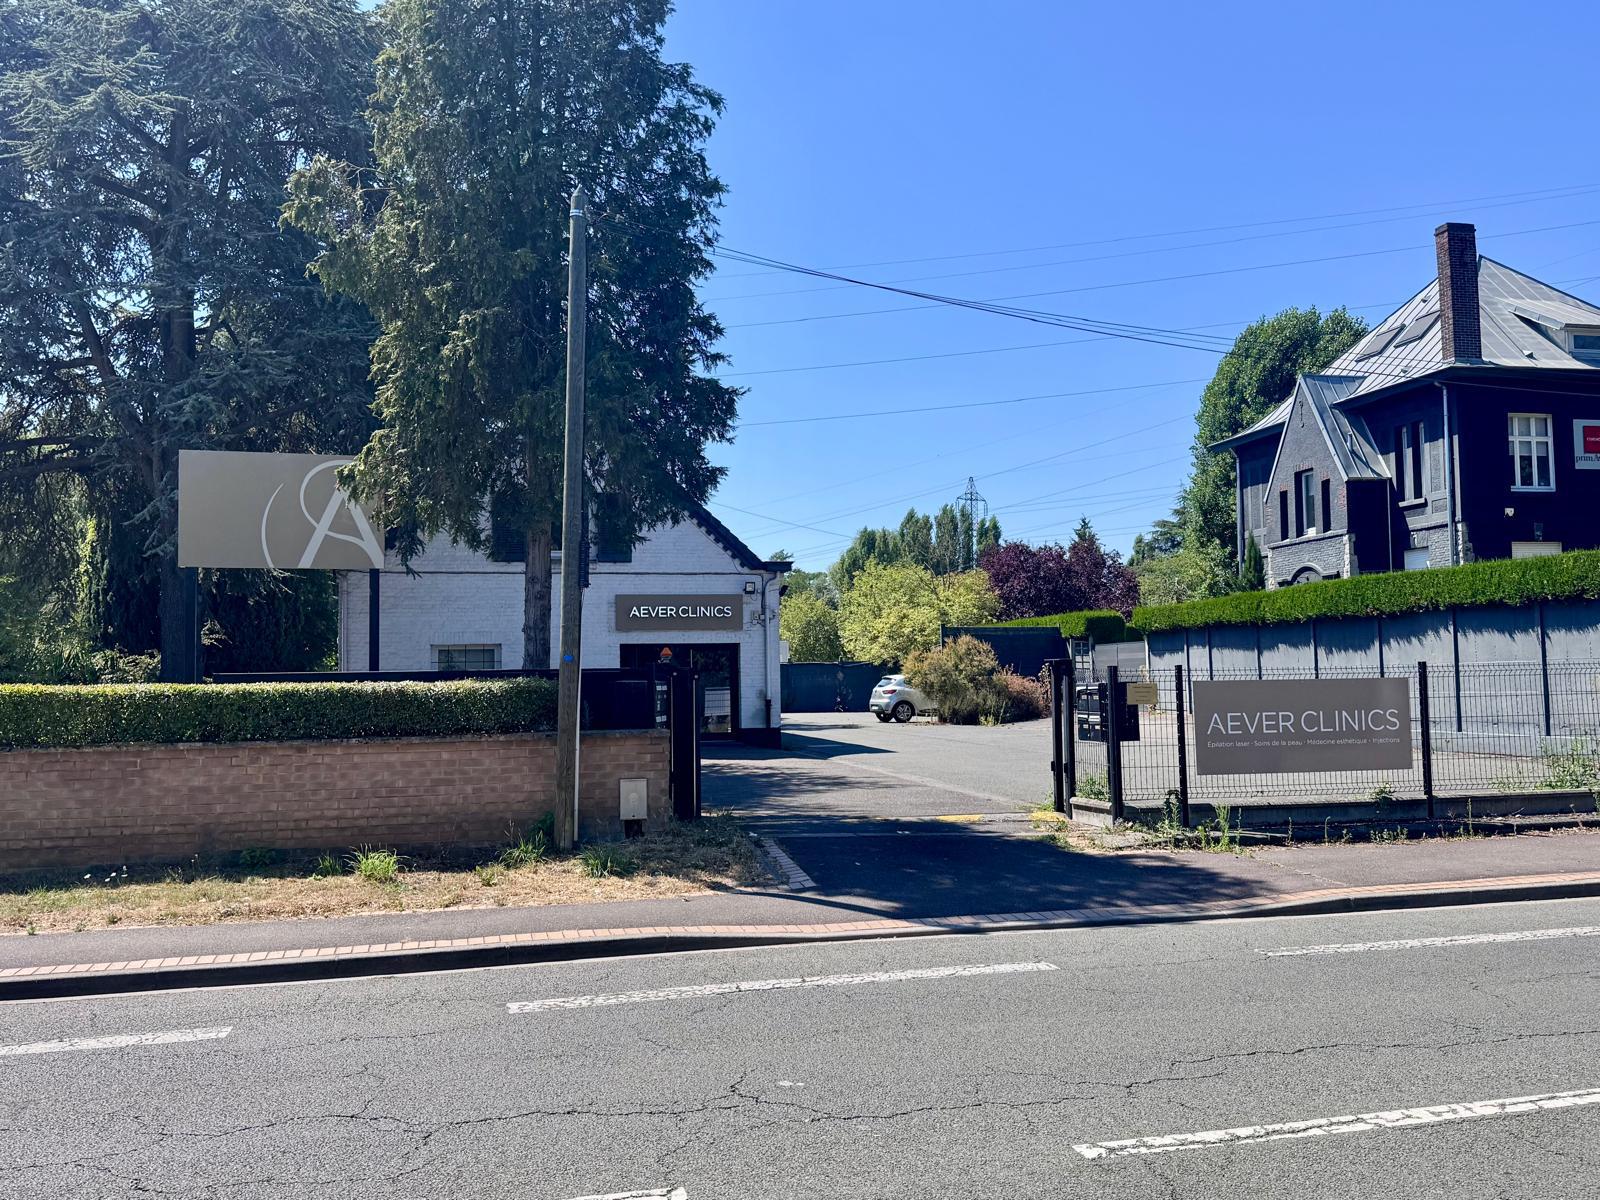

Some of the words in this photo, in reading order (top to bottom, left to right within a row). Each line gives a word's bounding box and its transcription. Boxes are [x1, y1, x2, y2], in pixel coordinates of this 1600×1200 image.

[629, 606, 677, 618] AEVER
[679, 606, 732, 617] CLINICS
[1207, 711, 1295, 735] AEVER
[1301, 709, 1400, 733] CLINICS
[1372, 737, 1400, 745] Injections
